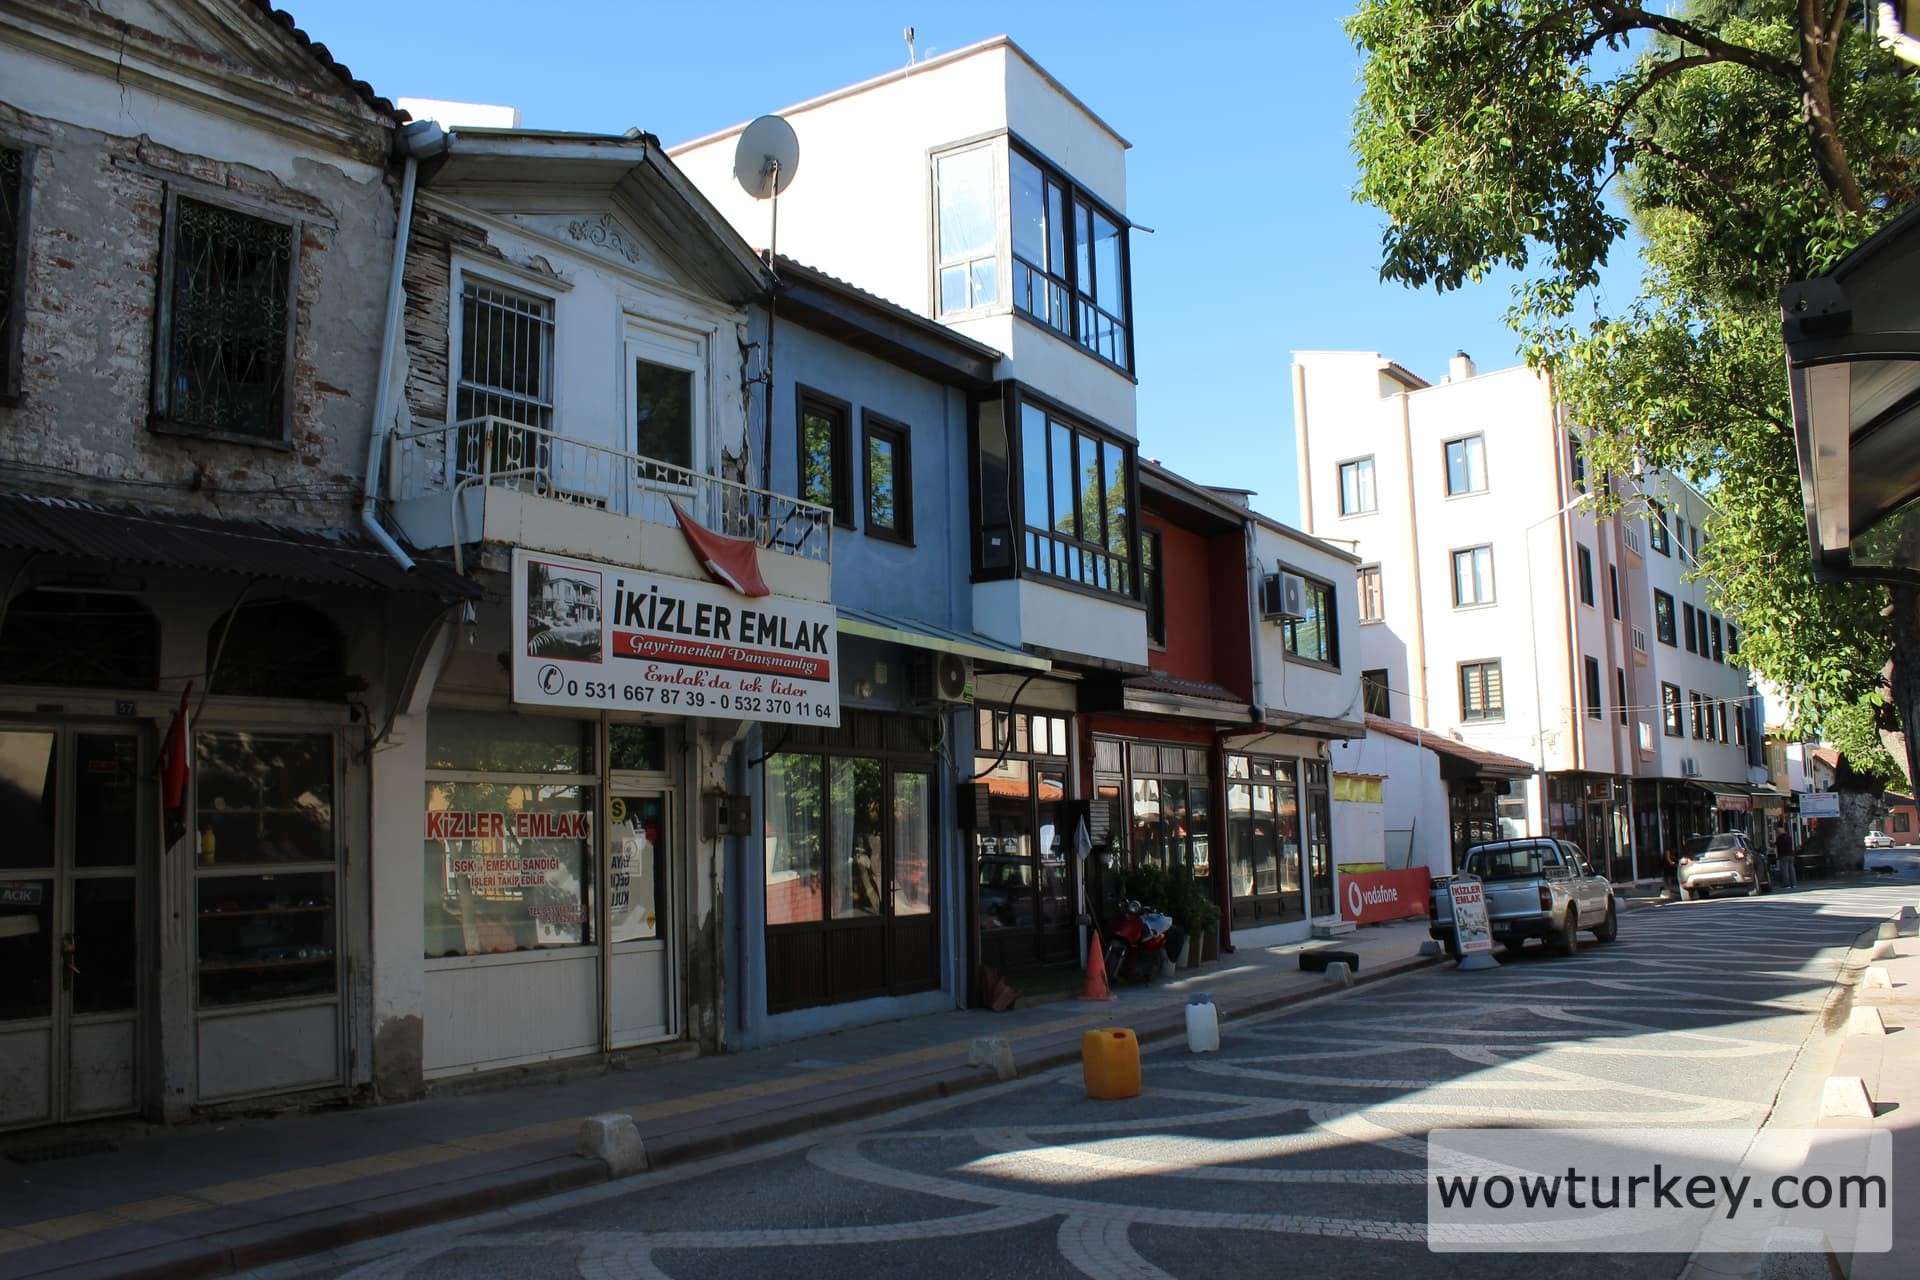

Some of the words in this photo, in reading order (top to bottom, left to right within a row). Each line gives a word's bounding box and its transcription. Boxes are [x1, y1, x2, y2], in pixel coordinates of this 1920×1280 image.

[613, 579, 732, 641] İKİZLER
[739, 608, 830, 655] EMLAK
[629, 635, 727, 659] Gayrimenkul
[644, 664, 732, 690] Emlak'da
[740, 676, 763, 693] tek
[770, 678, 807, 697] lider
[567, 680, 578, 696] 0
[585, 682, 615, 699] 531
[624, 685, 655, 702] 667
[661, 689, 680, 704] 87
[686, 691, 705, 707] 39
[720, 694, 729, 709] 0
[735, 696, 761, 712] 532
[766, 699, 791, 714] 370
[796, 702, 809, 716] 11
[815, 704, 831, 719] 64
[516, 812, 586, 838] EMLAK
[454, 860, 475, 873] SGK
[1363, 885, 1398, 905] vodafone
[1455, 895, 1481, 905] EMLAK
